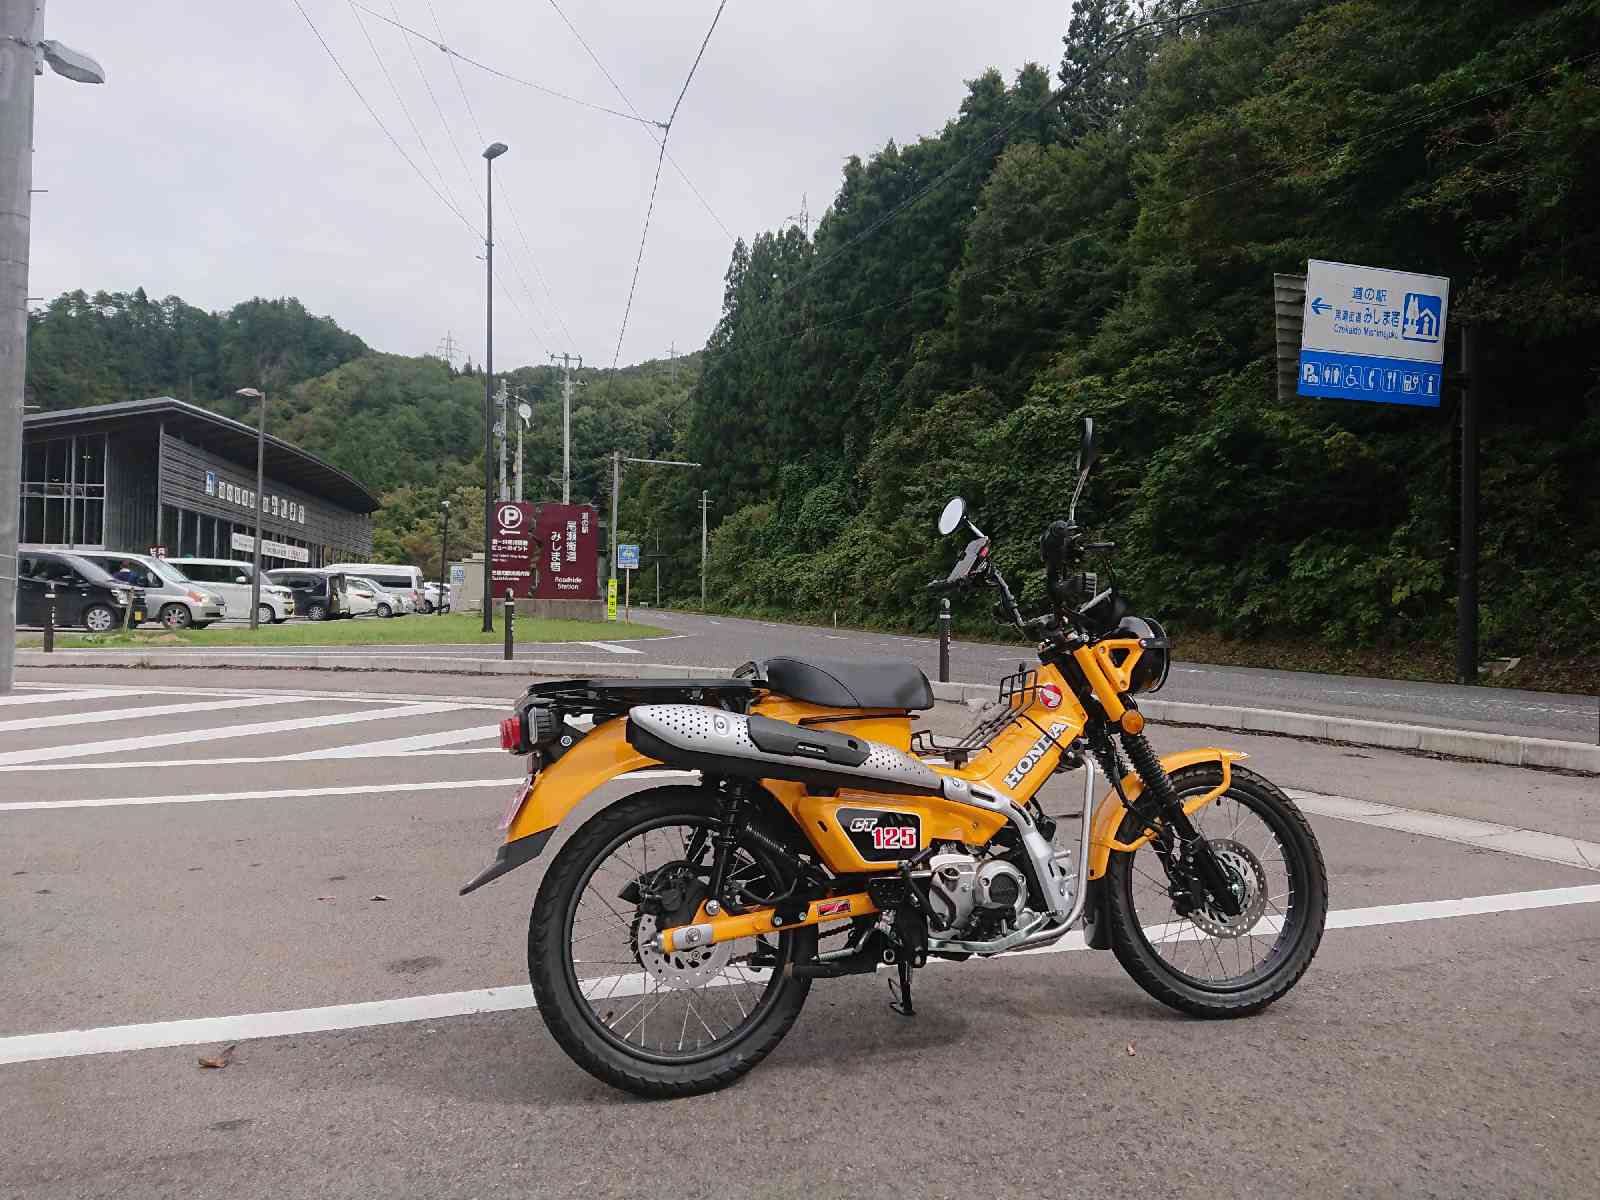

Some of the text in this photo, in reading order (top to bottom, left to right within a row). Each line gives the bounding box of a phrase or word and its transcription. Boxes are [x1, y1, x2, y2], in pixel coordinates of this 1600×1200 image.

[504, 508, 519, 525] P
[1003, 722, 1068, 790] HONDA
[850, 818, 917, 849] CT 125
